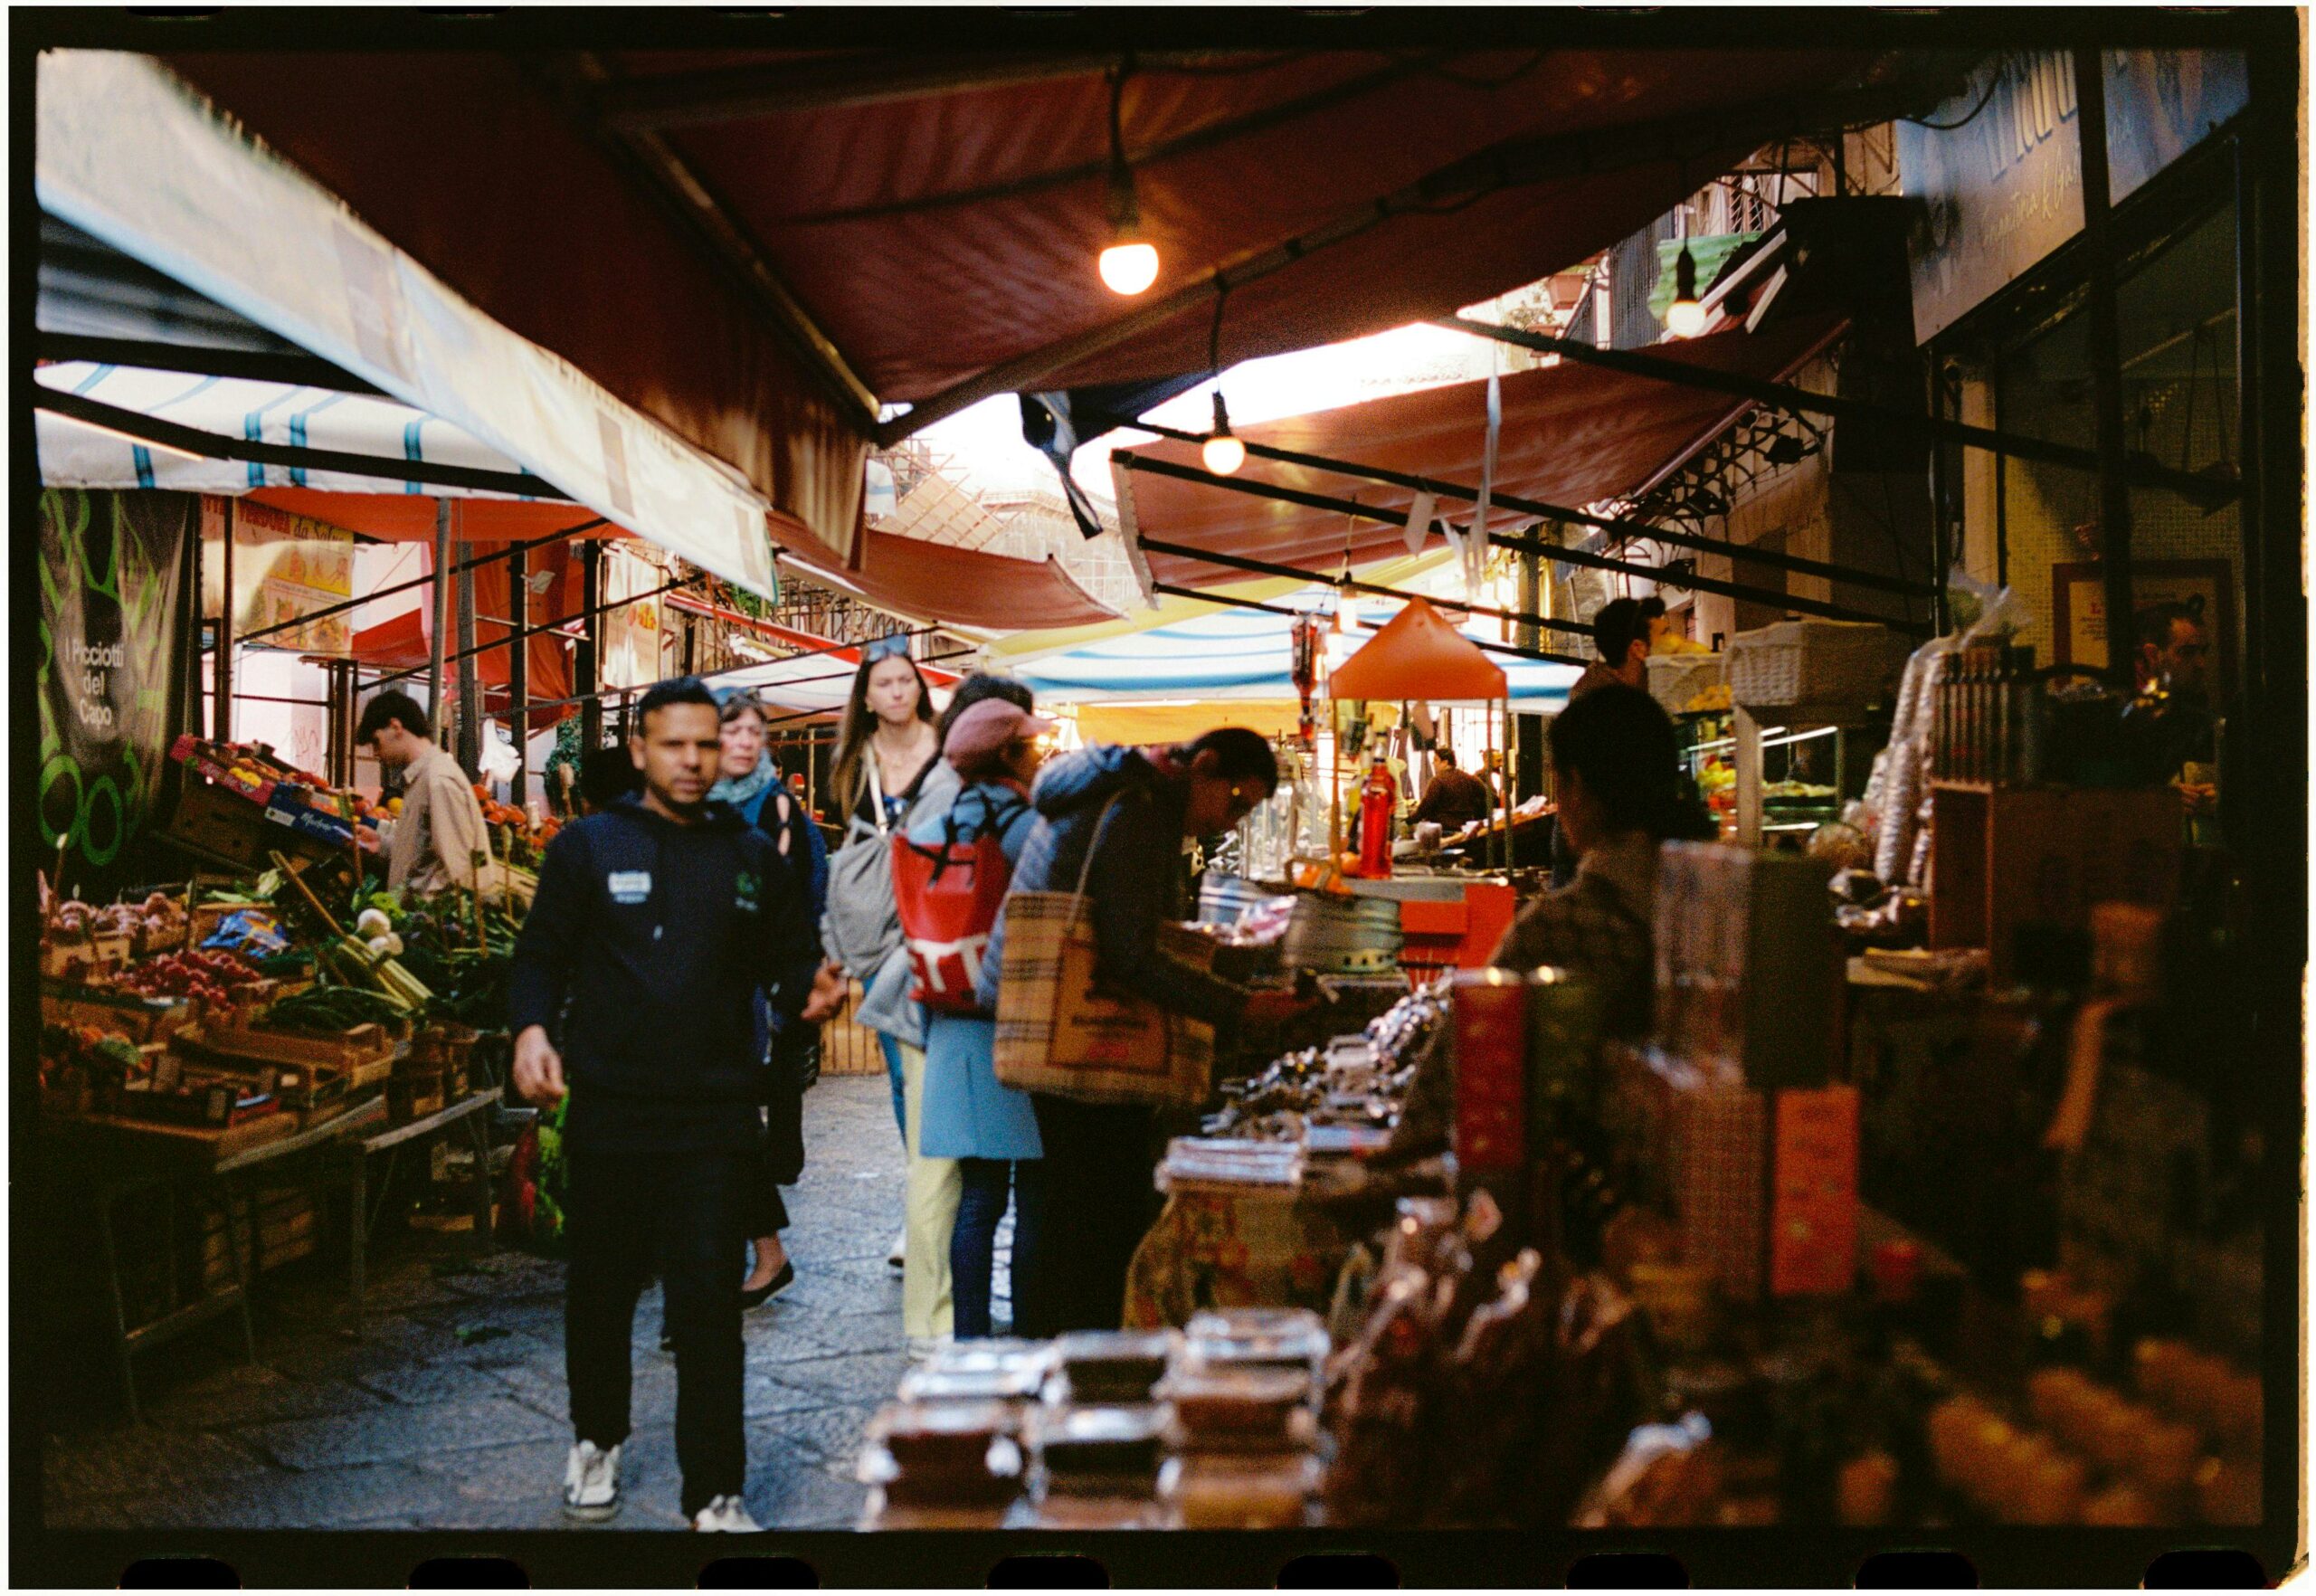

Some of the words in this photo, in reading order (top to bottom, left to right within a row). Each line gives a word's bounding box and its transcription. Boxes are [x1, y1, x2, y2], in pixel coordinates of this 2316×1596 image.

[73, 638, 125, 668] Picciotti
[83, 670, 105, 696] del
[79, 698, 112, 731] Capo
